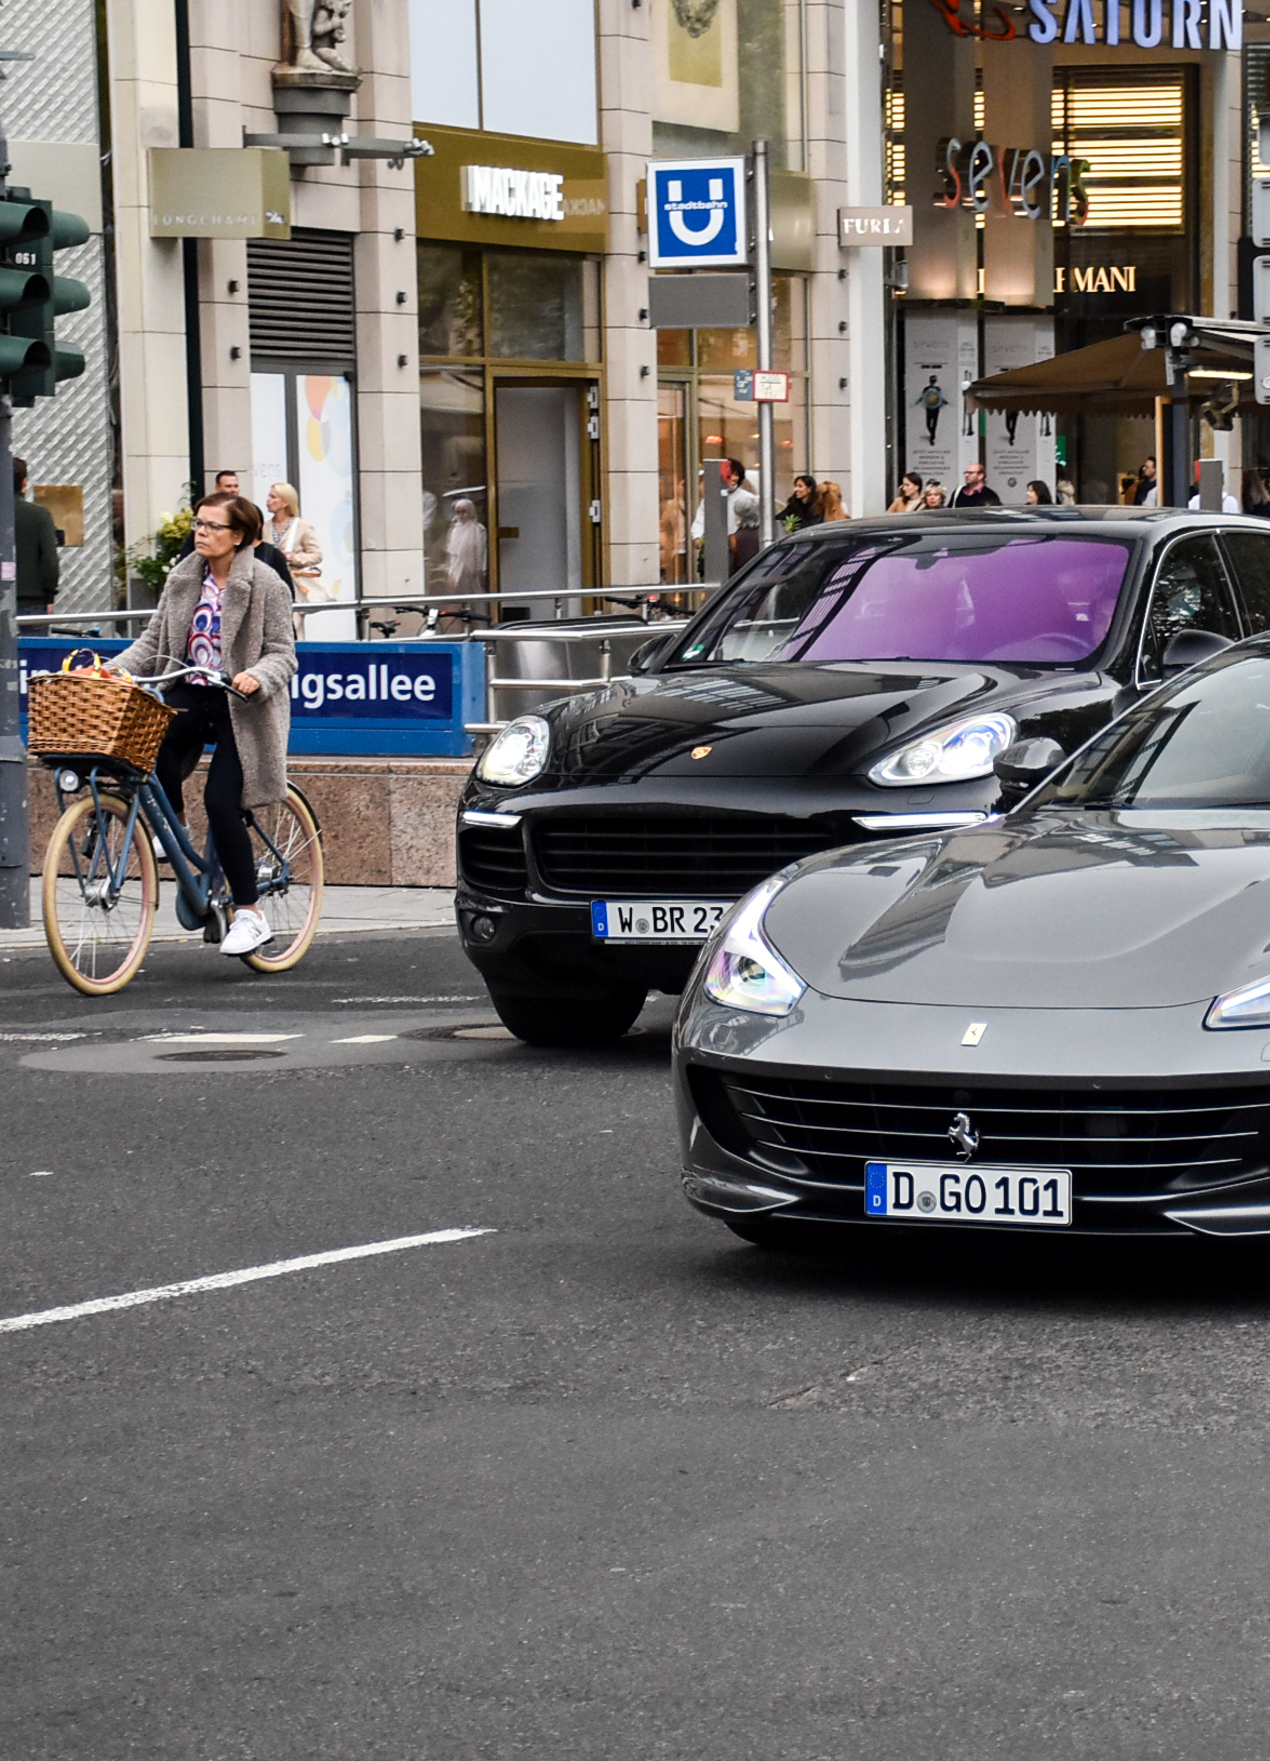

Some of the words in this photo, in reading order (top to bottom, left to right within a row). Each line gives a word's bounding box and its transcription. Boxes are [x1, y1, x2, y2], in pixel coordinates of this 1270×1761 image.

[1029, 0, 1243, 50] SATURN
[464, 164, 565, 221] MACKAGE
[664, 201, 728, 211] stadtbahn
[843, 218, 905, 235] FURLA
[617, 906, 633, 933] W
[652, 906, 686, 933] BR
[892, 1171, 915, 1210] D
[939, 1174, 987, 1214] GO
[994, 1176, 1064, 1217] 101
